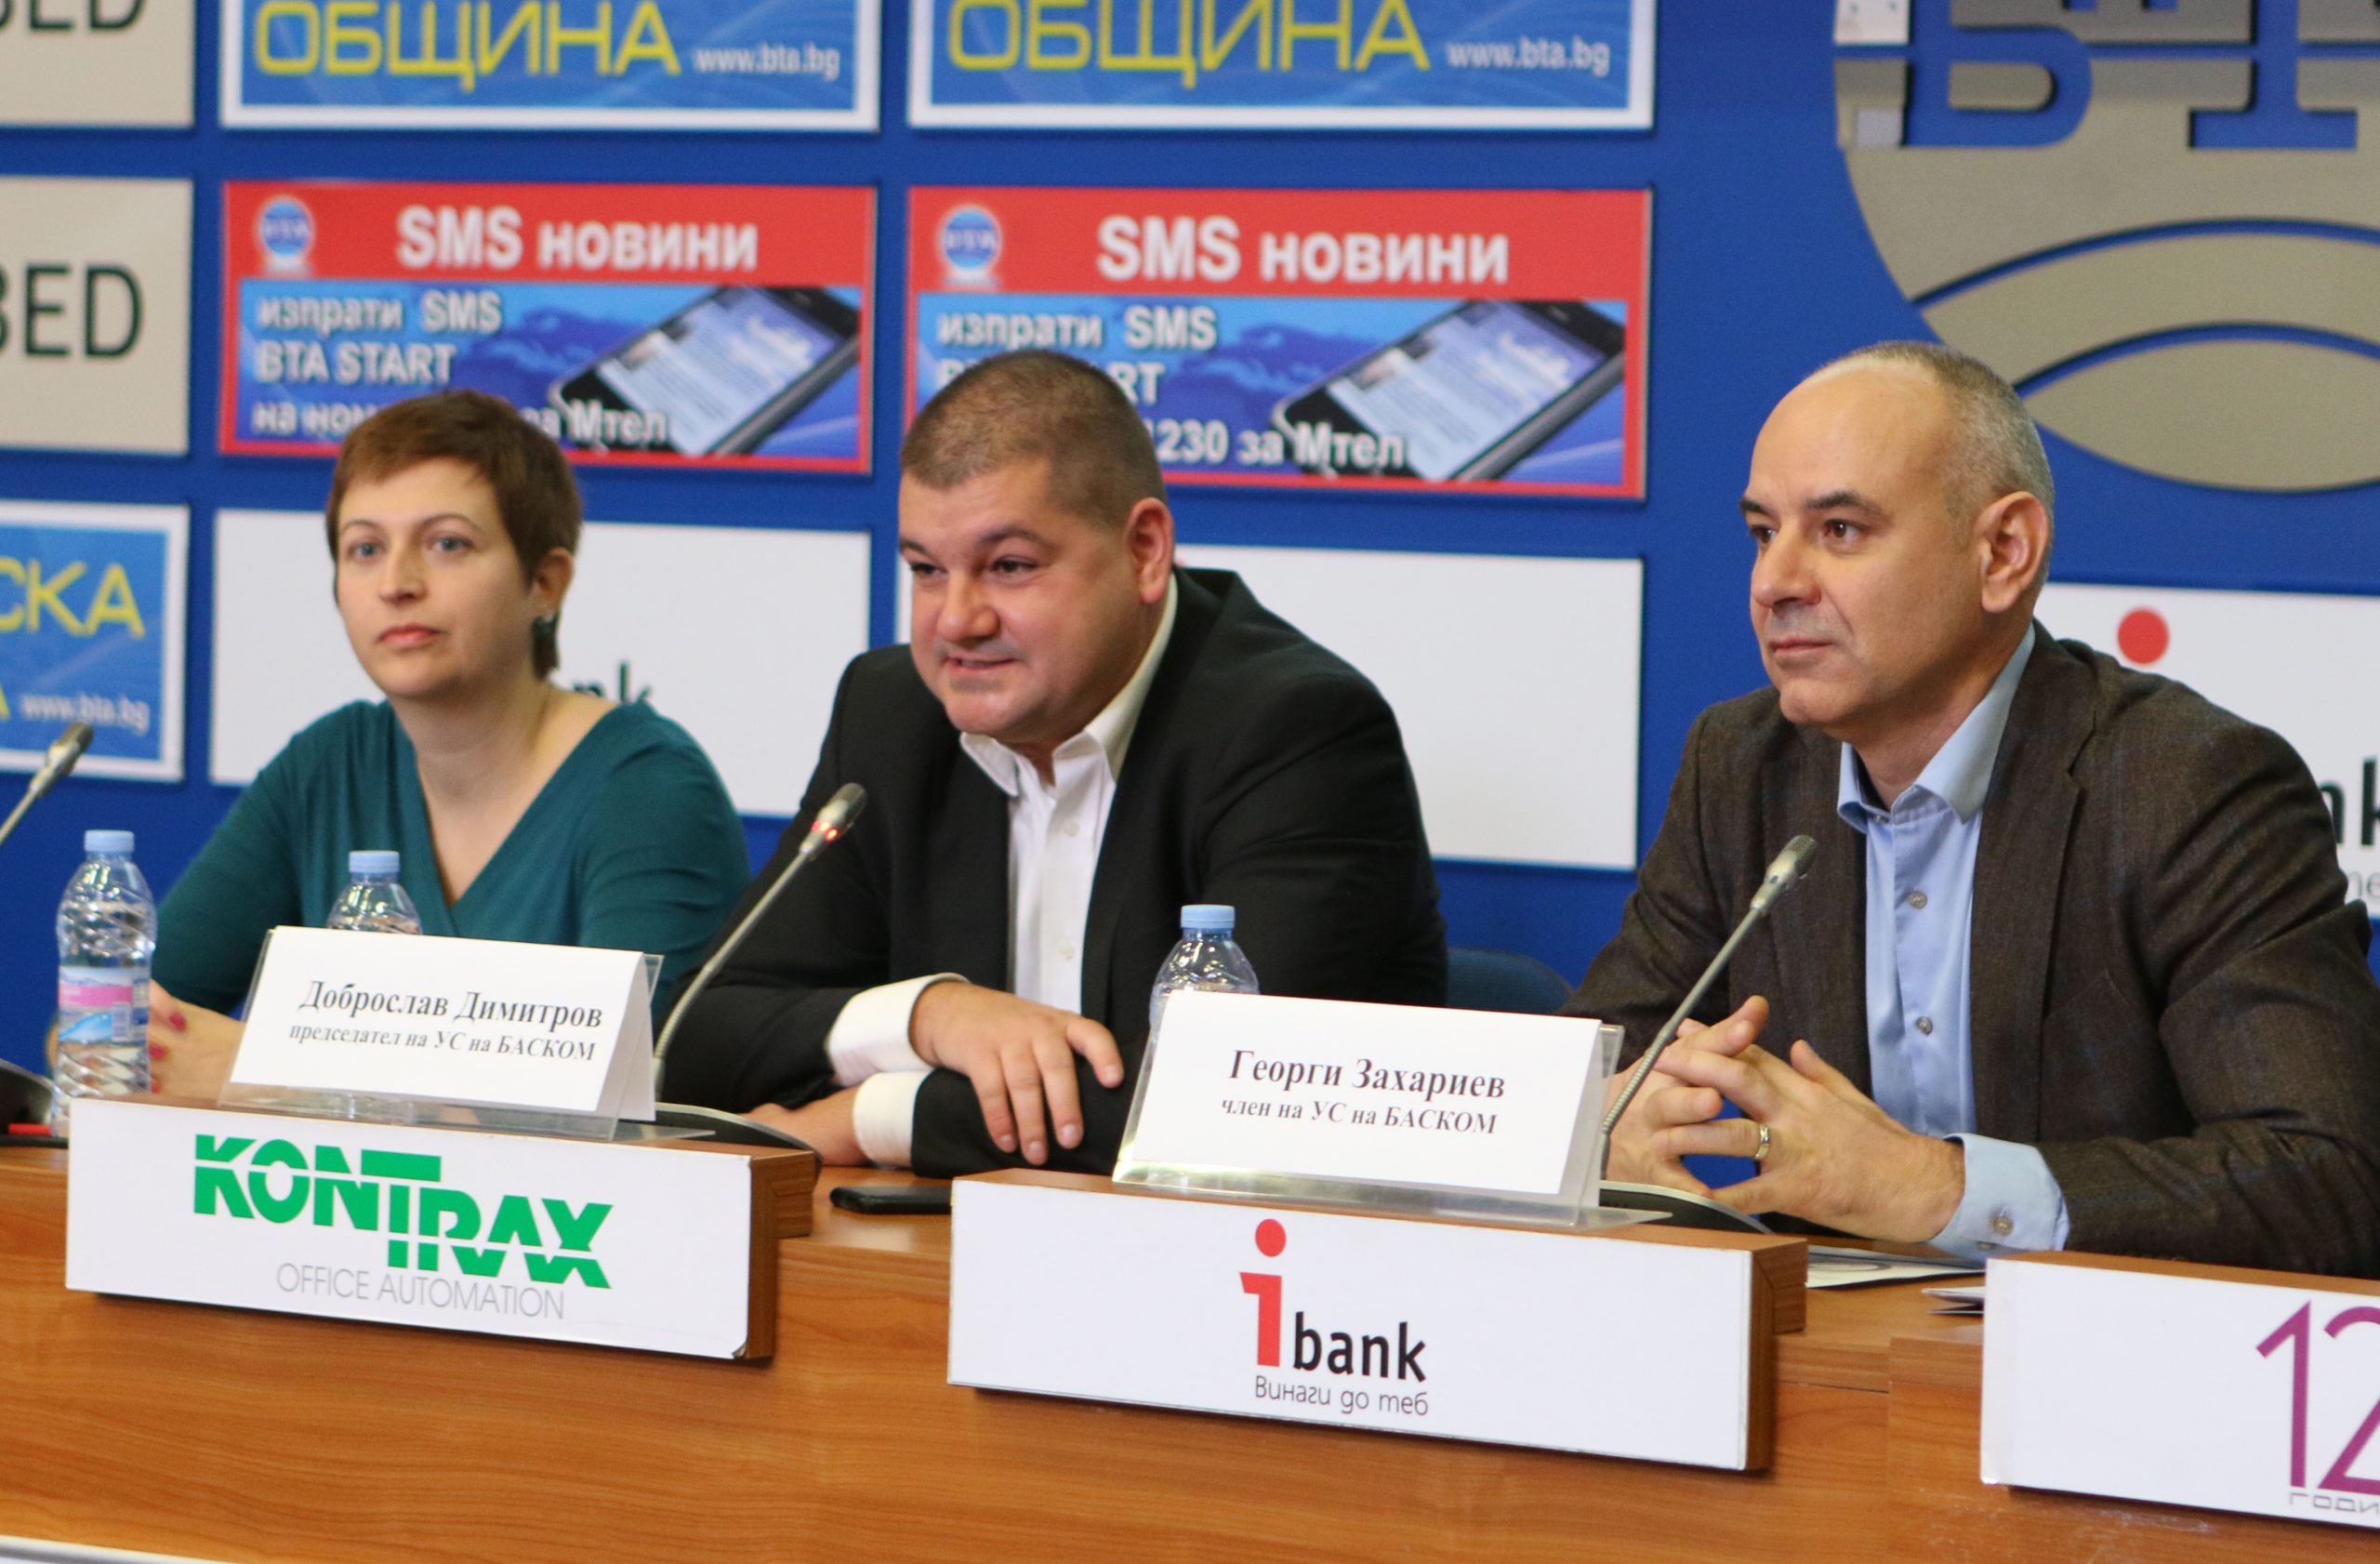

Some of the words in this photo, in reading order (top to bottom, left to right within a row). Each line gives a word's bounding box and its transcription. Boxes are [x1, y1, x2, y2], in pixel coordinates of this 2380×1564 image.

[255, 0, 681, 92] ОБЩИНА
[693, 43, 841, 82] www.bta.bg
[947, 0, 1432, 89] ОБЩИНА
[1447, 35, 1610, 77] www.bta.bg
[396, 205, 523, 271] SMS
[1096, 214, 1242, 283] SMS
[0, 263, 144, 358] ED
[257, 298, 403, 338] изпрати
[421, 289, 503, 334] SMS
[936, 312, 1104, 350] изпрати
[1123, 305, 1218, 351] SMS
[336, 340, 456, 386] START
[252, 401, 298, 435] на
[567, 399, 668, 445] Мтел
[1144, 418, 1228, 464] 230
[1237, 430, 1285, 464] за
[1293, 421, 1406, 467] Мтел
[298, 980, 449, 1017] Доброслав
[454, 991, 602, 1033] Димитров
[289, 1024, 401, 1046] председател
[405, 1034, 428, 1048] на
[434, 1030, 466, 1051] УС
[469, 1039, 492, 1054] на
[497, 1035, 597, 1062] БАСКОМ
[1228, 1049, 1344, 1093] Георги
[1353, 1058, 1506, 1102] Захариев
[1222, 1098, 1271, 1117] член
[1277, 1103, 1303, 1120] на
[1311, 1100, 1346, 1123] УС
[1351, 1107, 1377, 1126] на
[1383, 1107, 1498, 1134] БАСКОМ
[193, 1133, 614, 1290] KONTRAX
[276, 1263, 370, 1302] OFFICE
[377, 1274, 564, 1320] AUTOMATION
[1255, 1375, 1331, 1406] Винаги
[1341, 1389, 1369, 1414] до
[1378, 1391, 1429, 1416] теб
[2255, 1300, 2380, 1496] 12
